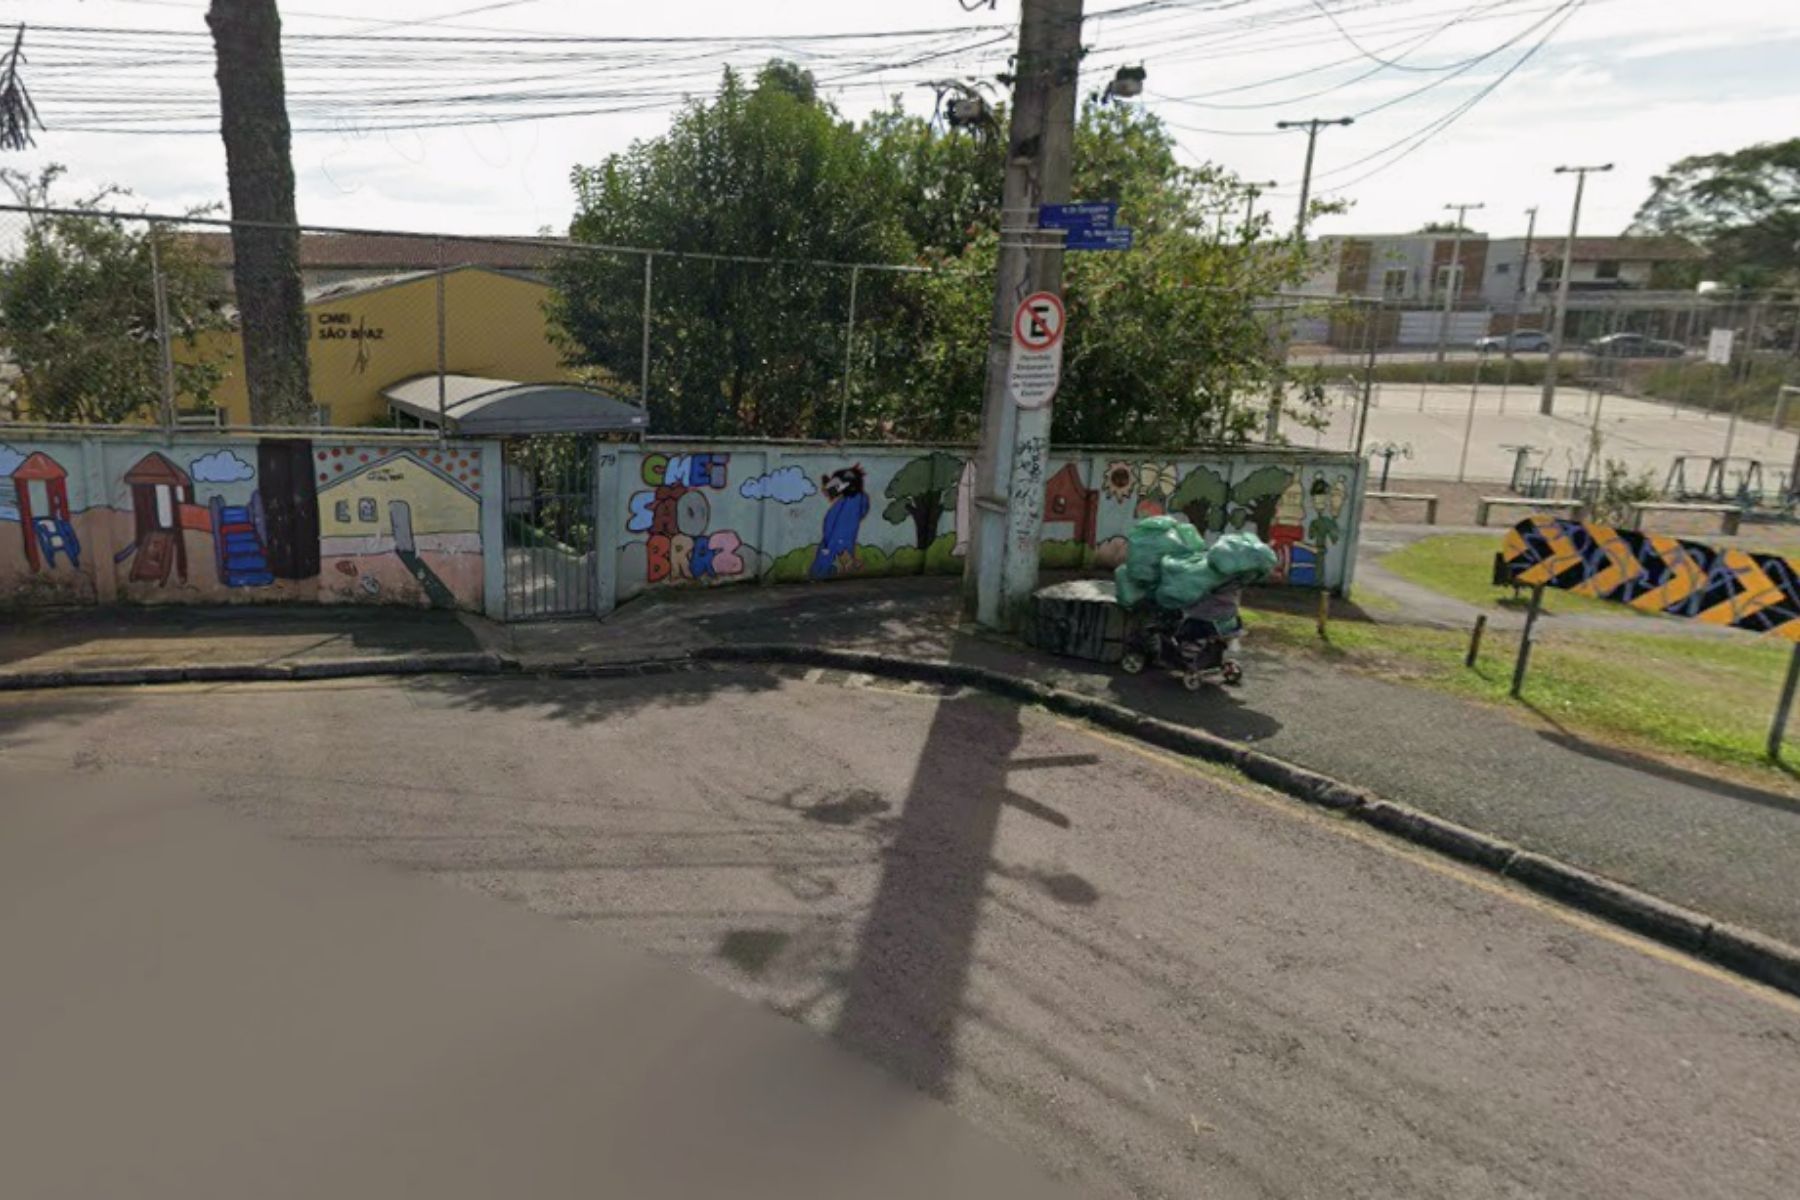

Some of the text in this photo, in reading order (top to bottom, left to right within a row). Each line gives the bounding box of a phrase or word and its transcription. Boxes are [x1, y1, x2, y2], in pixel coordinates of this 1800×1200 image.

[319, 312, 351, 325] CMEI
[319, 326, 346, 339] SÃO
[600, 454, 616, 468] 79
[646, 530, 745, 582] BRAZ
